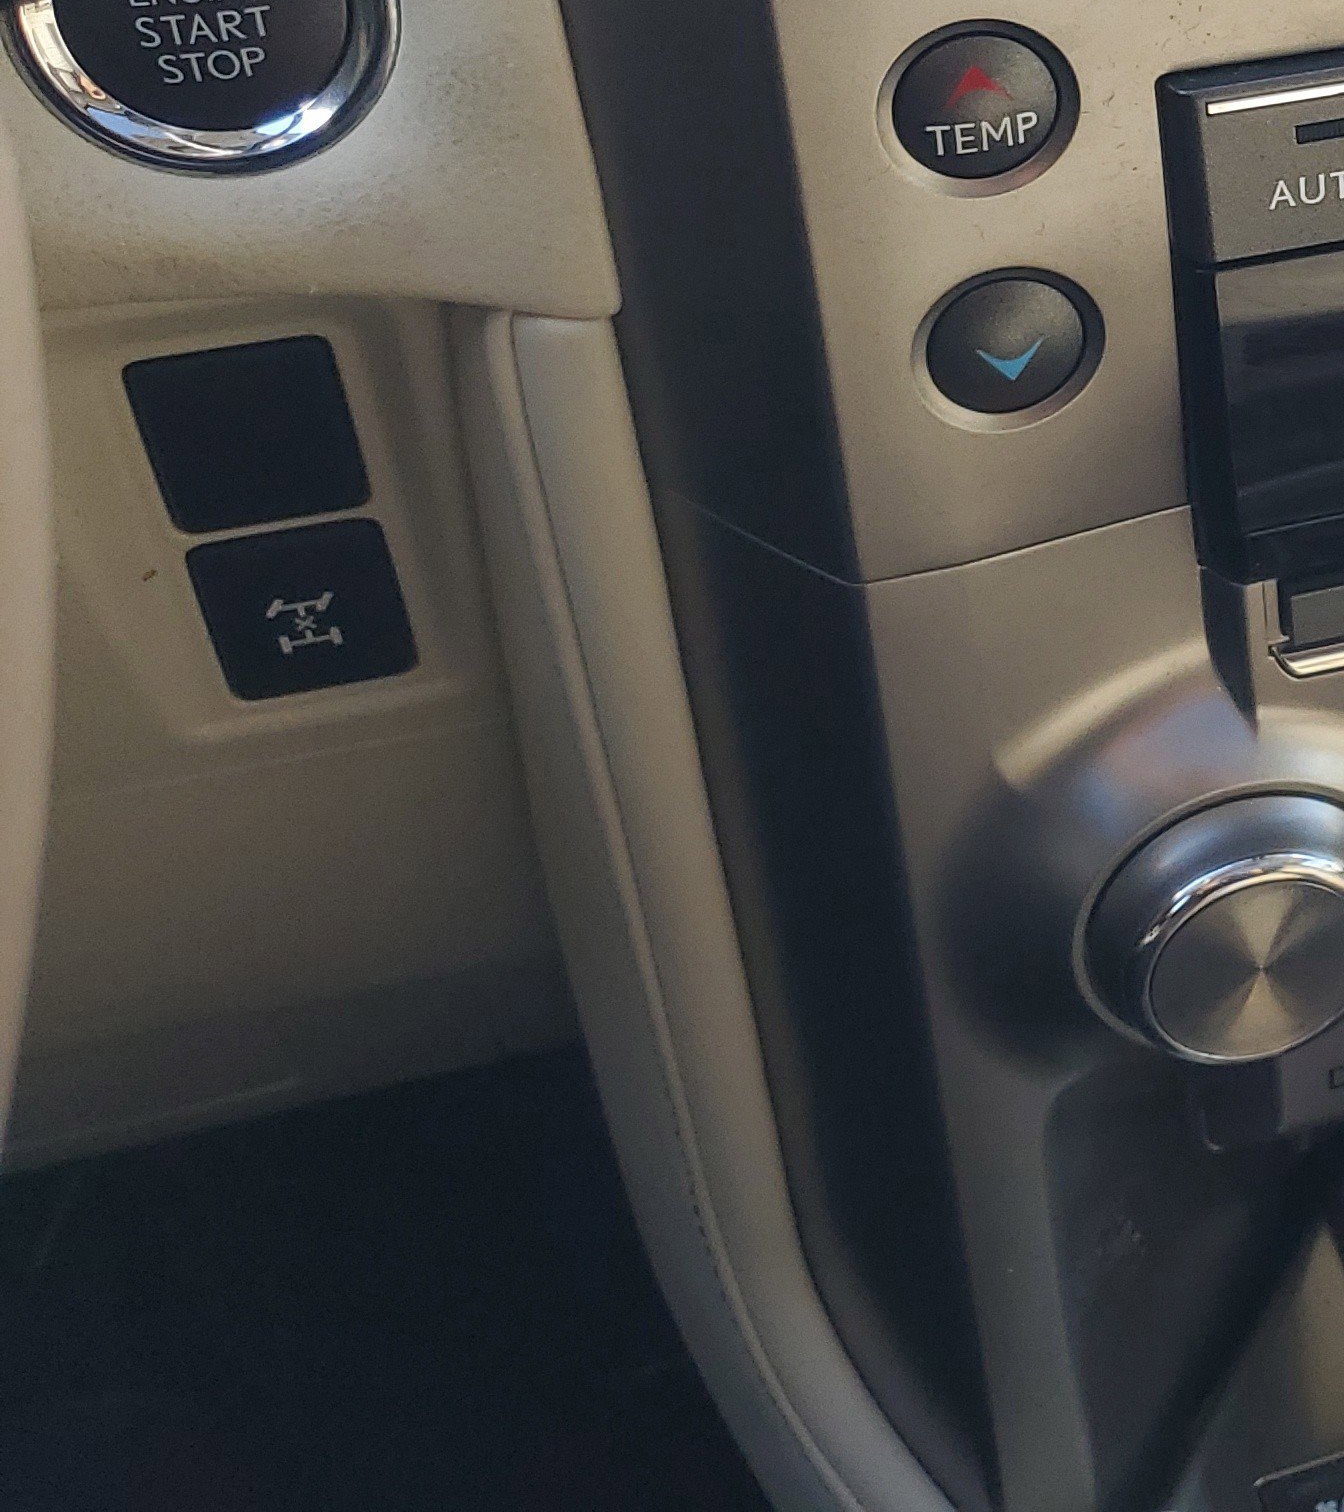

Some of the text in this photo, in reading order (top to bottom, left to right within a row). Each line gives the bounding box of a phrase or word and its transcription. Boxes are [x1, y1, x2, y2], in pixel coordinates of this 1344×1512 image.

[135, 5, 271, 48] START
[157, 47, 266, 84] STOP
[925, 110, 1039, 157] TEMP
